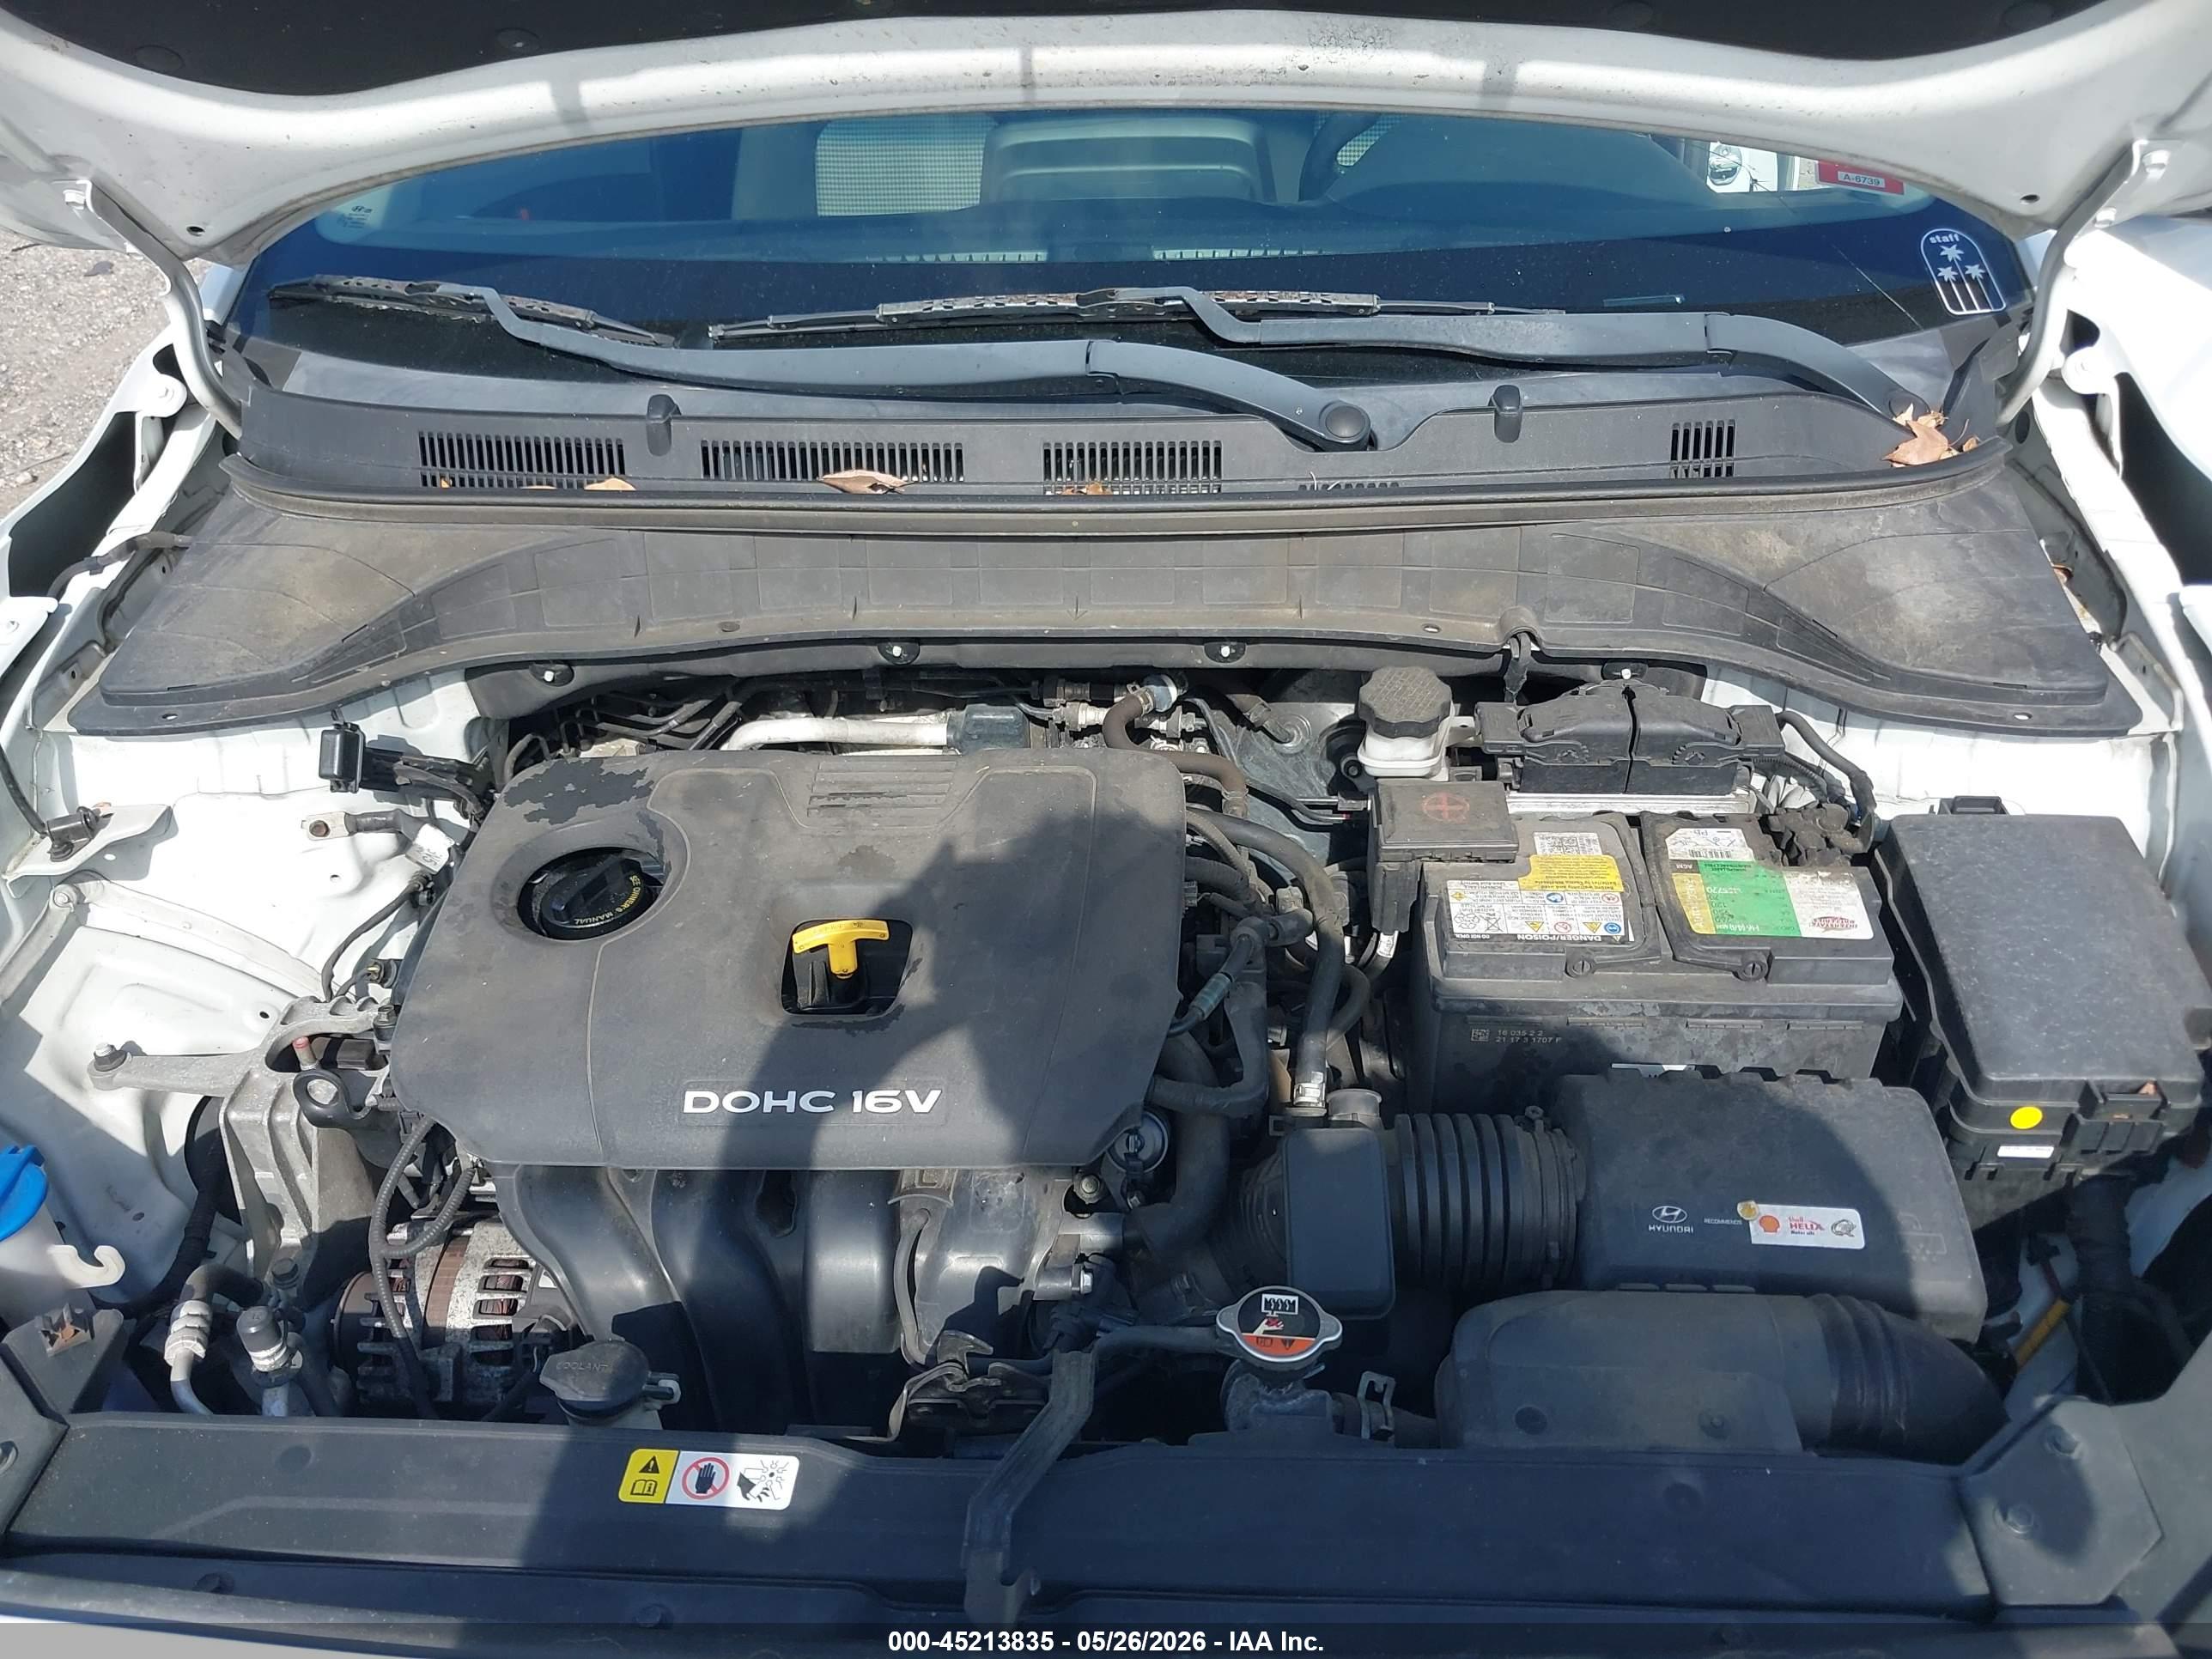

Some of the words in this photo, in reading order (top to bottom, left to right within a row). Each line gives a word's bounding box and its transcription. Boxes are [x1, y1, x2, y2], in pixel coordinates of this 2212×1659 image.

[1843, 173, 1881, 186] A-6739
[1929, 234, 1960, 244] staff
[629, 875, 641, 886] SEE
[574, 912, 614, 925] MANUAL
[683, 1090, 836, 1114] DOHC
[852, 1089, 943, 1114] 16V
[1649, 1224, 1693, 1233] HYUNDAI
[1790, 1221, 1826, 1231] HELIX
[556, 1361, 609, 1371] COOLANT
